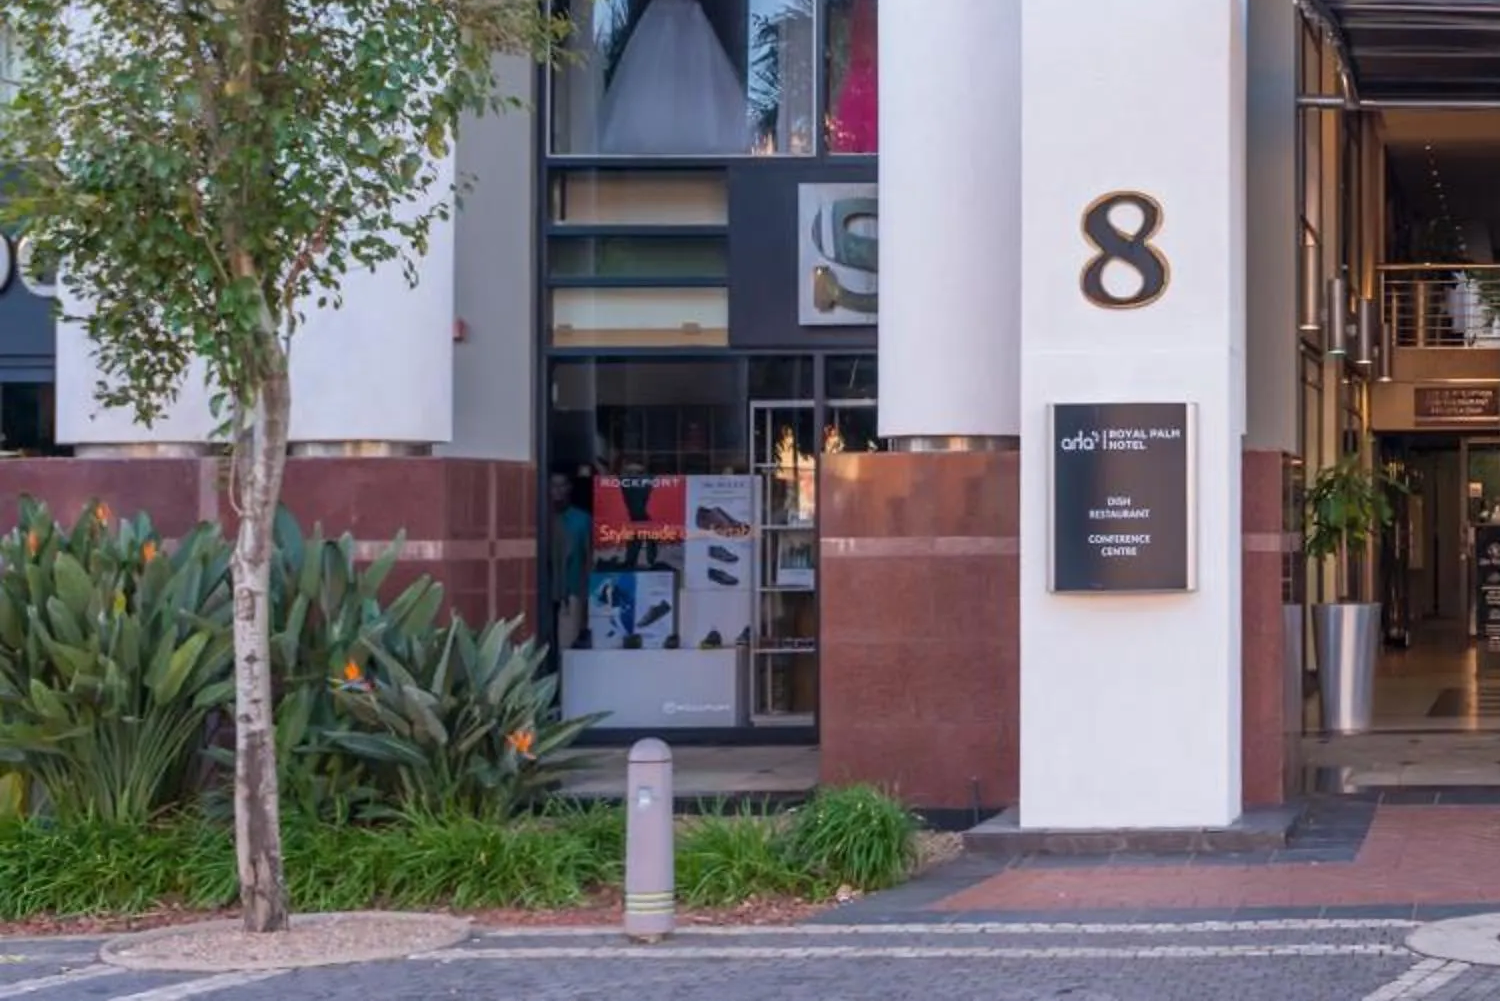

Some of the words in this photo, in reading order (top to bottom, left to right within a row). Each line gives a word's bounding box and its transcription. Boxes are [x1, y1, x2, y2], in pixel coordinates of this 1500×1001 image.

[1080, 190, 1171, 309] 8
[1109, 429, 1147, 439] ROYAL
[1149, 428, 1180, 439] PALM
[1109, 440, 1147, 450] HOTEL
[601, 478, 680, 488] ROCKPORT
[1107, 496, 1131, 506] DISH
[1089, 509, 1150, 519] RESTAURANT
[1088, 534, 1150, 545] CONFERENCE
[1101, 546, 1137, 557] CENTRE
